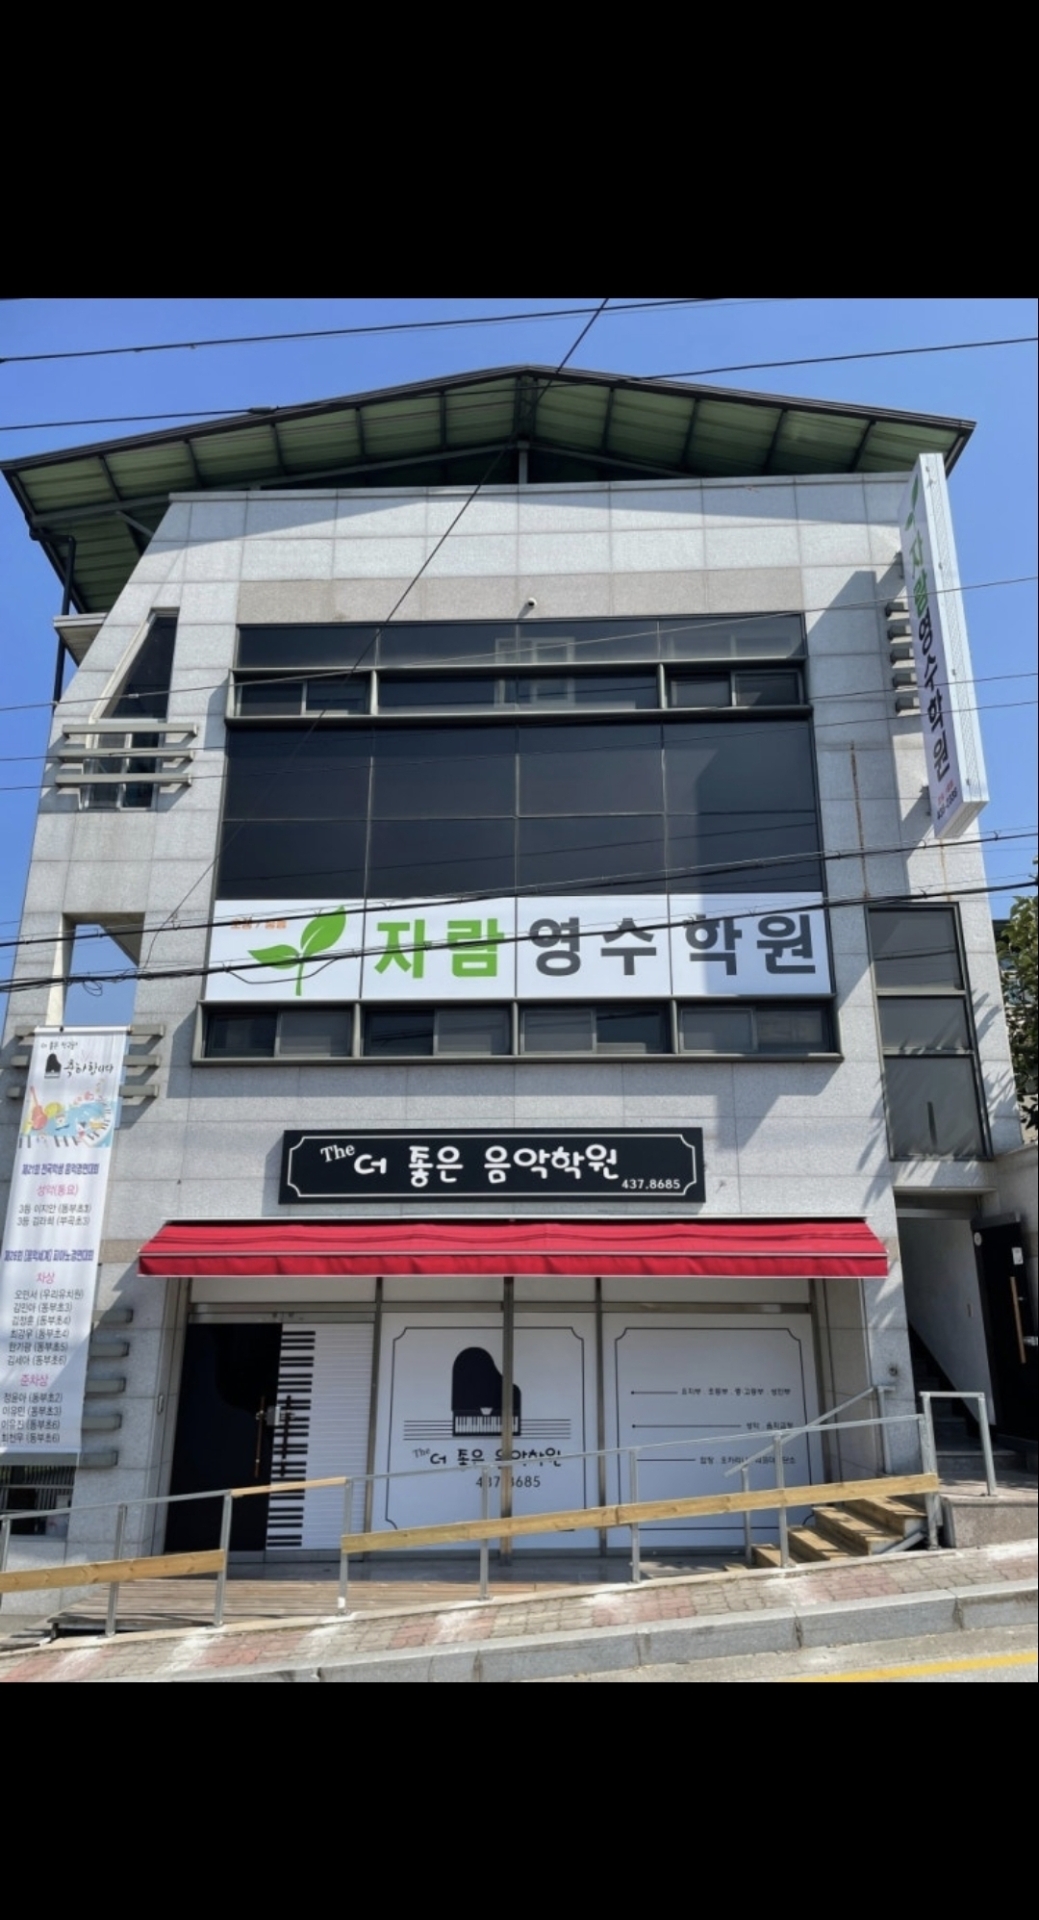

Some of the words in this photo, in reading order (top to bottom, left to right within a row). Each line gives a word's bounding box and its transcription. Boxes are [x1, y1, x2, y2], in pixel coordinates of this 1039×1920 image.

[63, 1058, 114, 1078] 축하합니다
[320, 1142, 355, 1163] The
[354, 1154, 387, 1175] 더
[408, 1145, 463, 1187] 좋은
[484, 1143, 619, 1184] 음악학원
[622, 1178, 681, 1190] 437.8685
[37, 1272, 55, 1284] 차상
[20, 1374, 49, 1387] 준차상
[413, 1448, 430, 1458] The
[430, 1453, 447, 1464] 더
